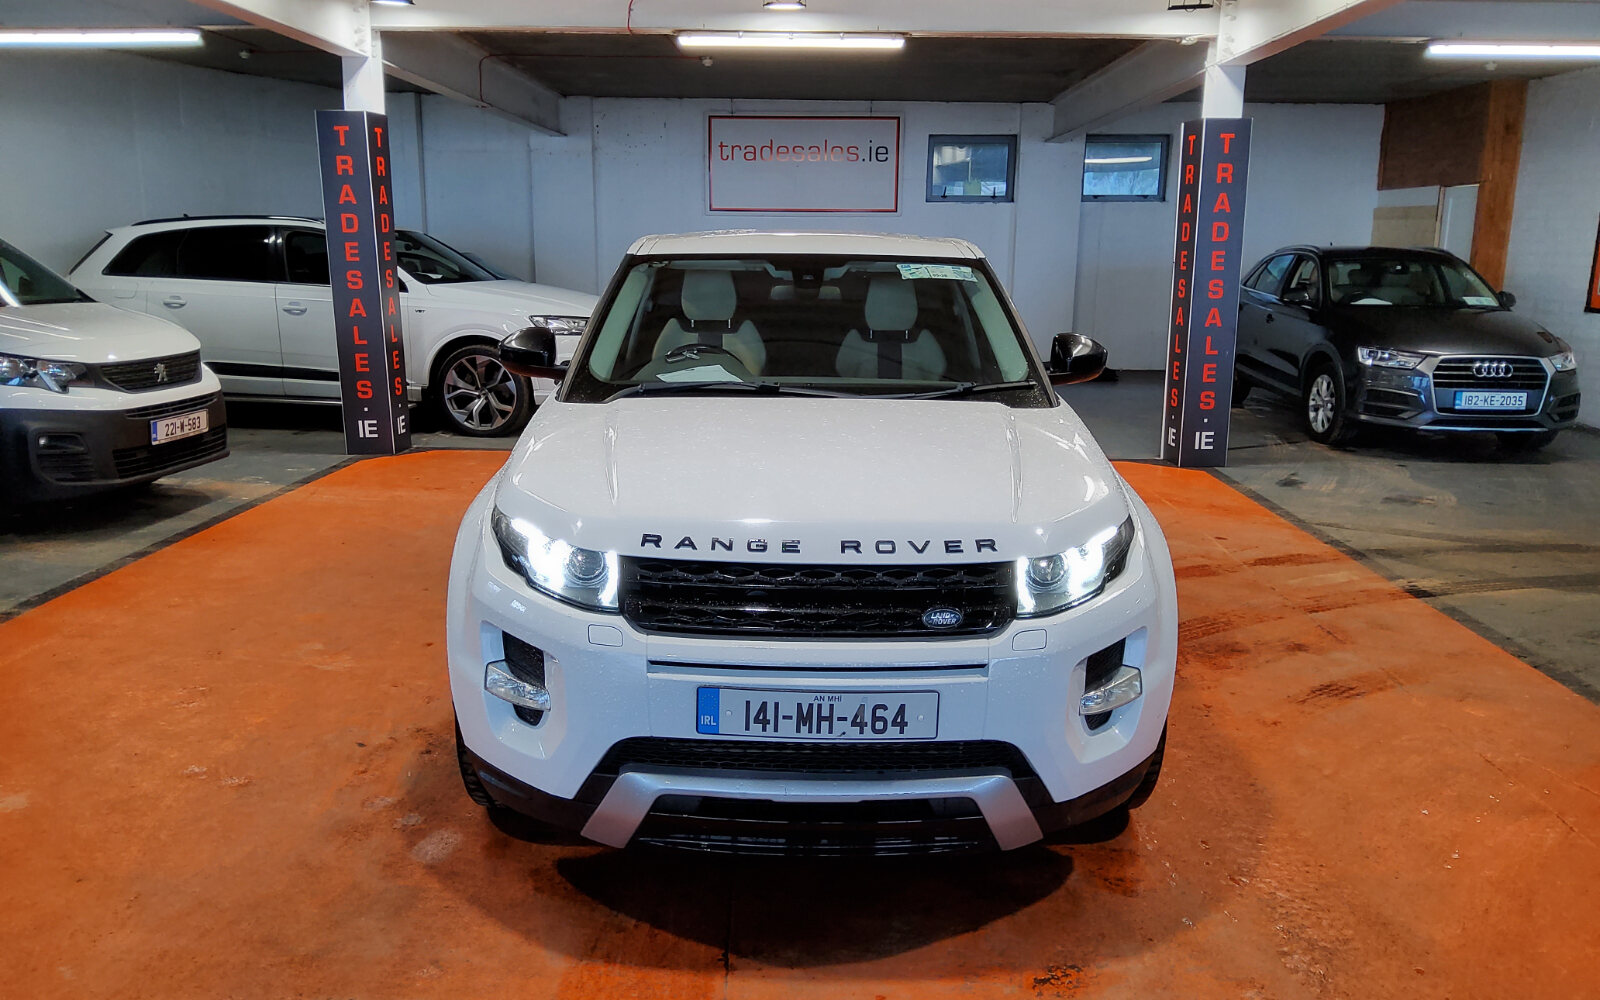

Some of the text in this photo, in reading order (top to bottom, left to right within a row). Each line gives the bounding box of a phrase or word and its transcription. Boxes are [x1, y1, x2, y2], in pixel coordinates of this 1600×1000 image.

[718, 138, 889, 163] tradesales.ie
[333, 125, 379, 438] TRADESALES.IE
[374, 127, 406, 435] TRADESALES.IE
[1167, 134, 1197, 447] TRADESALES.IE
[1194, 133, 1236, 450] TRADESALES.IE
[1464, 395, 1524, 406] 182-KE-2035
[164, 416, 201, 437] 221-W-583
[640, 533, 999, 554] RANGE ROVER
[700, 714, 717, 726] IRL
[744, 700, 909, 735] 141-MH-464
